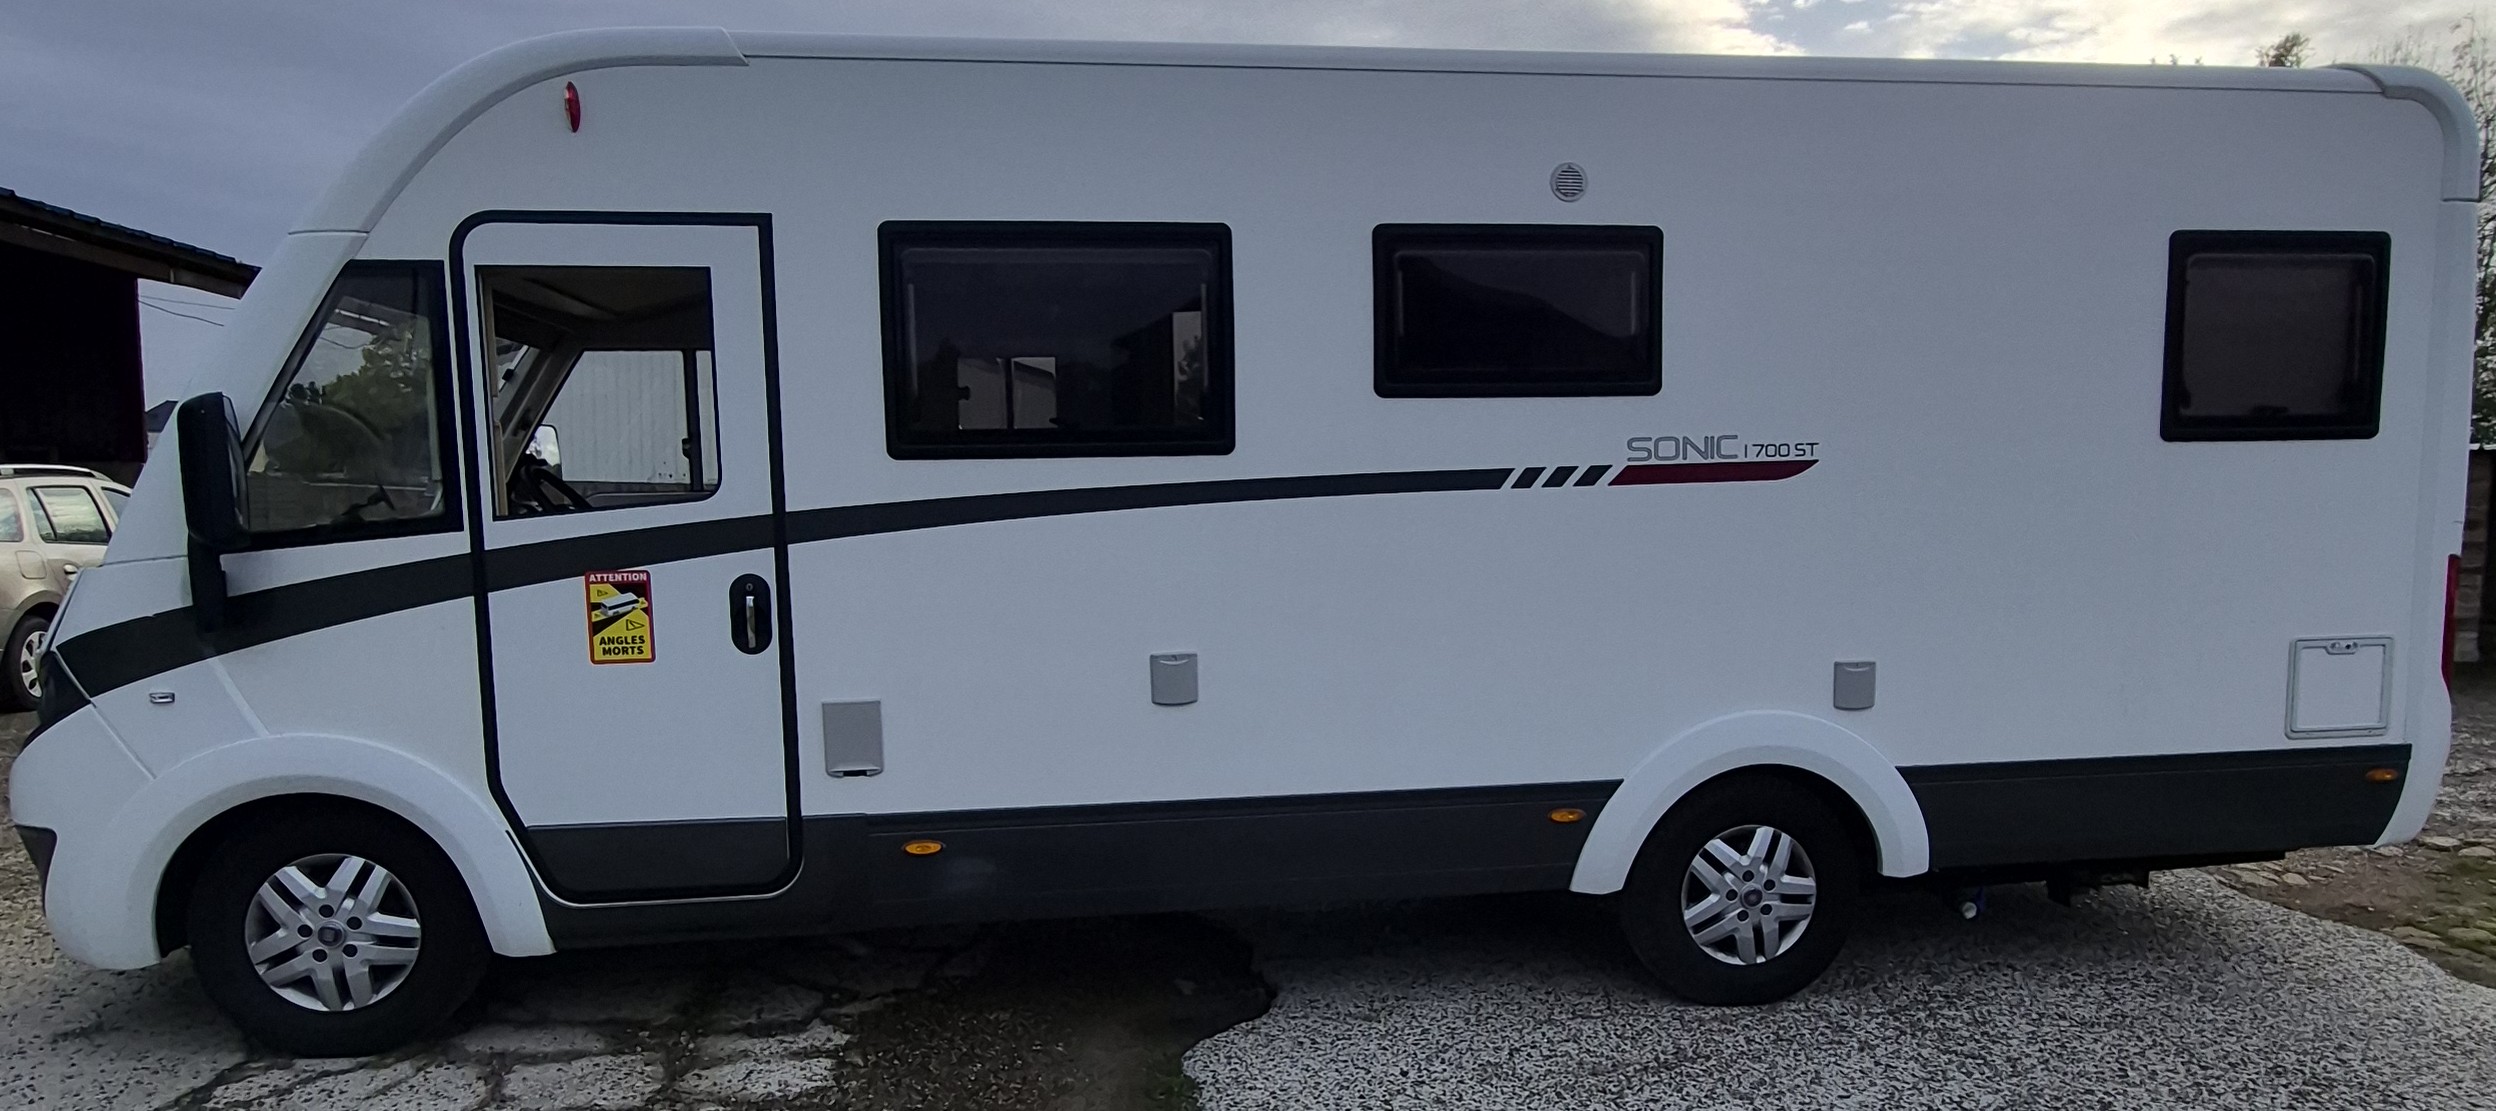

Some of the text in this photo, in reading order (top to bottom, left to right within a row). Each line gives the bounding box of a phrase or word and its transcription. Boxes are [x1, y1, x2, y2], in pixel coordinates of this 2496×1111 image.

[1627, 434, 1738, 461] SONIC
[1752, 443, 1790, 458] 700
[1794, 442, 1820, 457] ST
[589, 573, 647, 582] ATTENTION
[599, 635, 646, 646] ANGLES
[602, 646, 644, 656] MORTS
